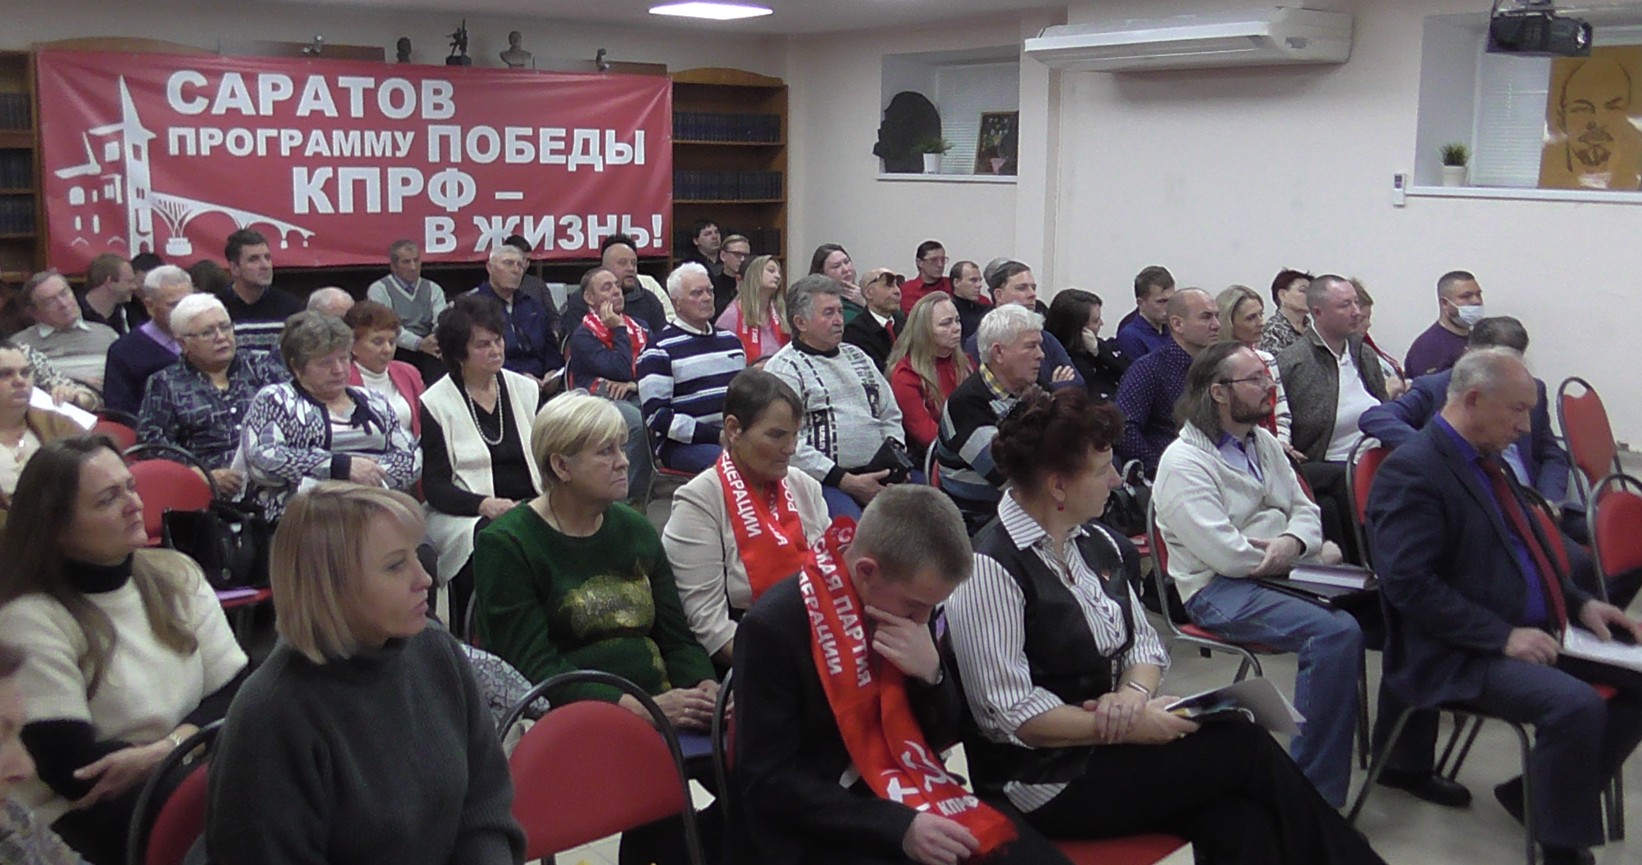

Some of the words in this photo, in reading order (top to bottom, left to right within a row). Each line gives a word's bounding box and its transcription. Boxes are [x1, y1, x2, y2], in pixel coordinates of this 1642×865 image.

[167, 71, 455, 119] САРАТОВ
[168, 127, 414, 157] ПРОГРАММУ
[427, 125, 646, 172] ПОБЕДЫ
[293, 167, 476, 213] КПРФ
[425, 217, 457, 253] В
[474, 214, 662, 253] ЖИЗНЬ!
[721, 449, 762, 538] ЕДЕРАЦИИ
[833, 595, 872, 688] ПАРТИЯ
